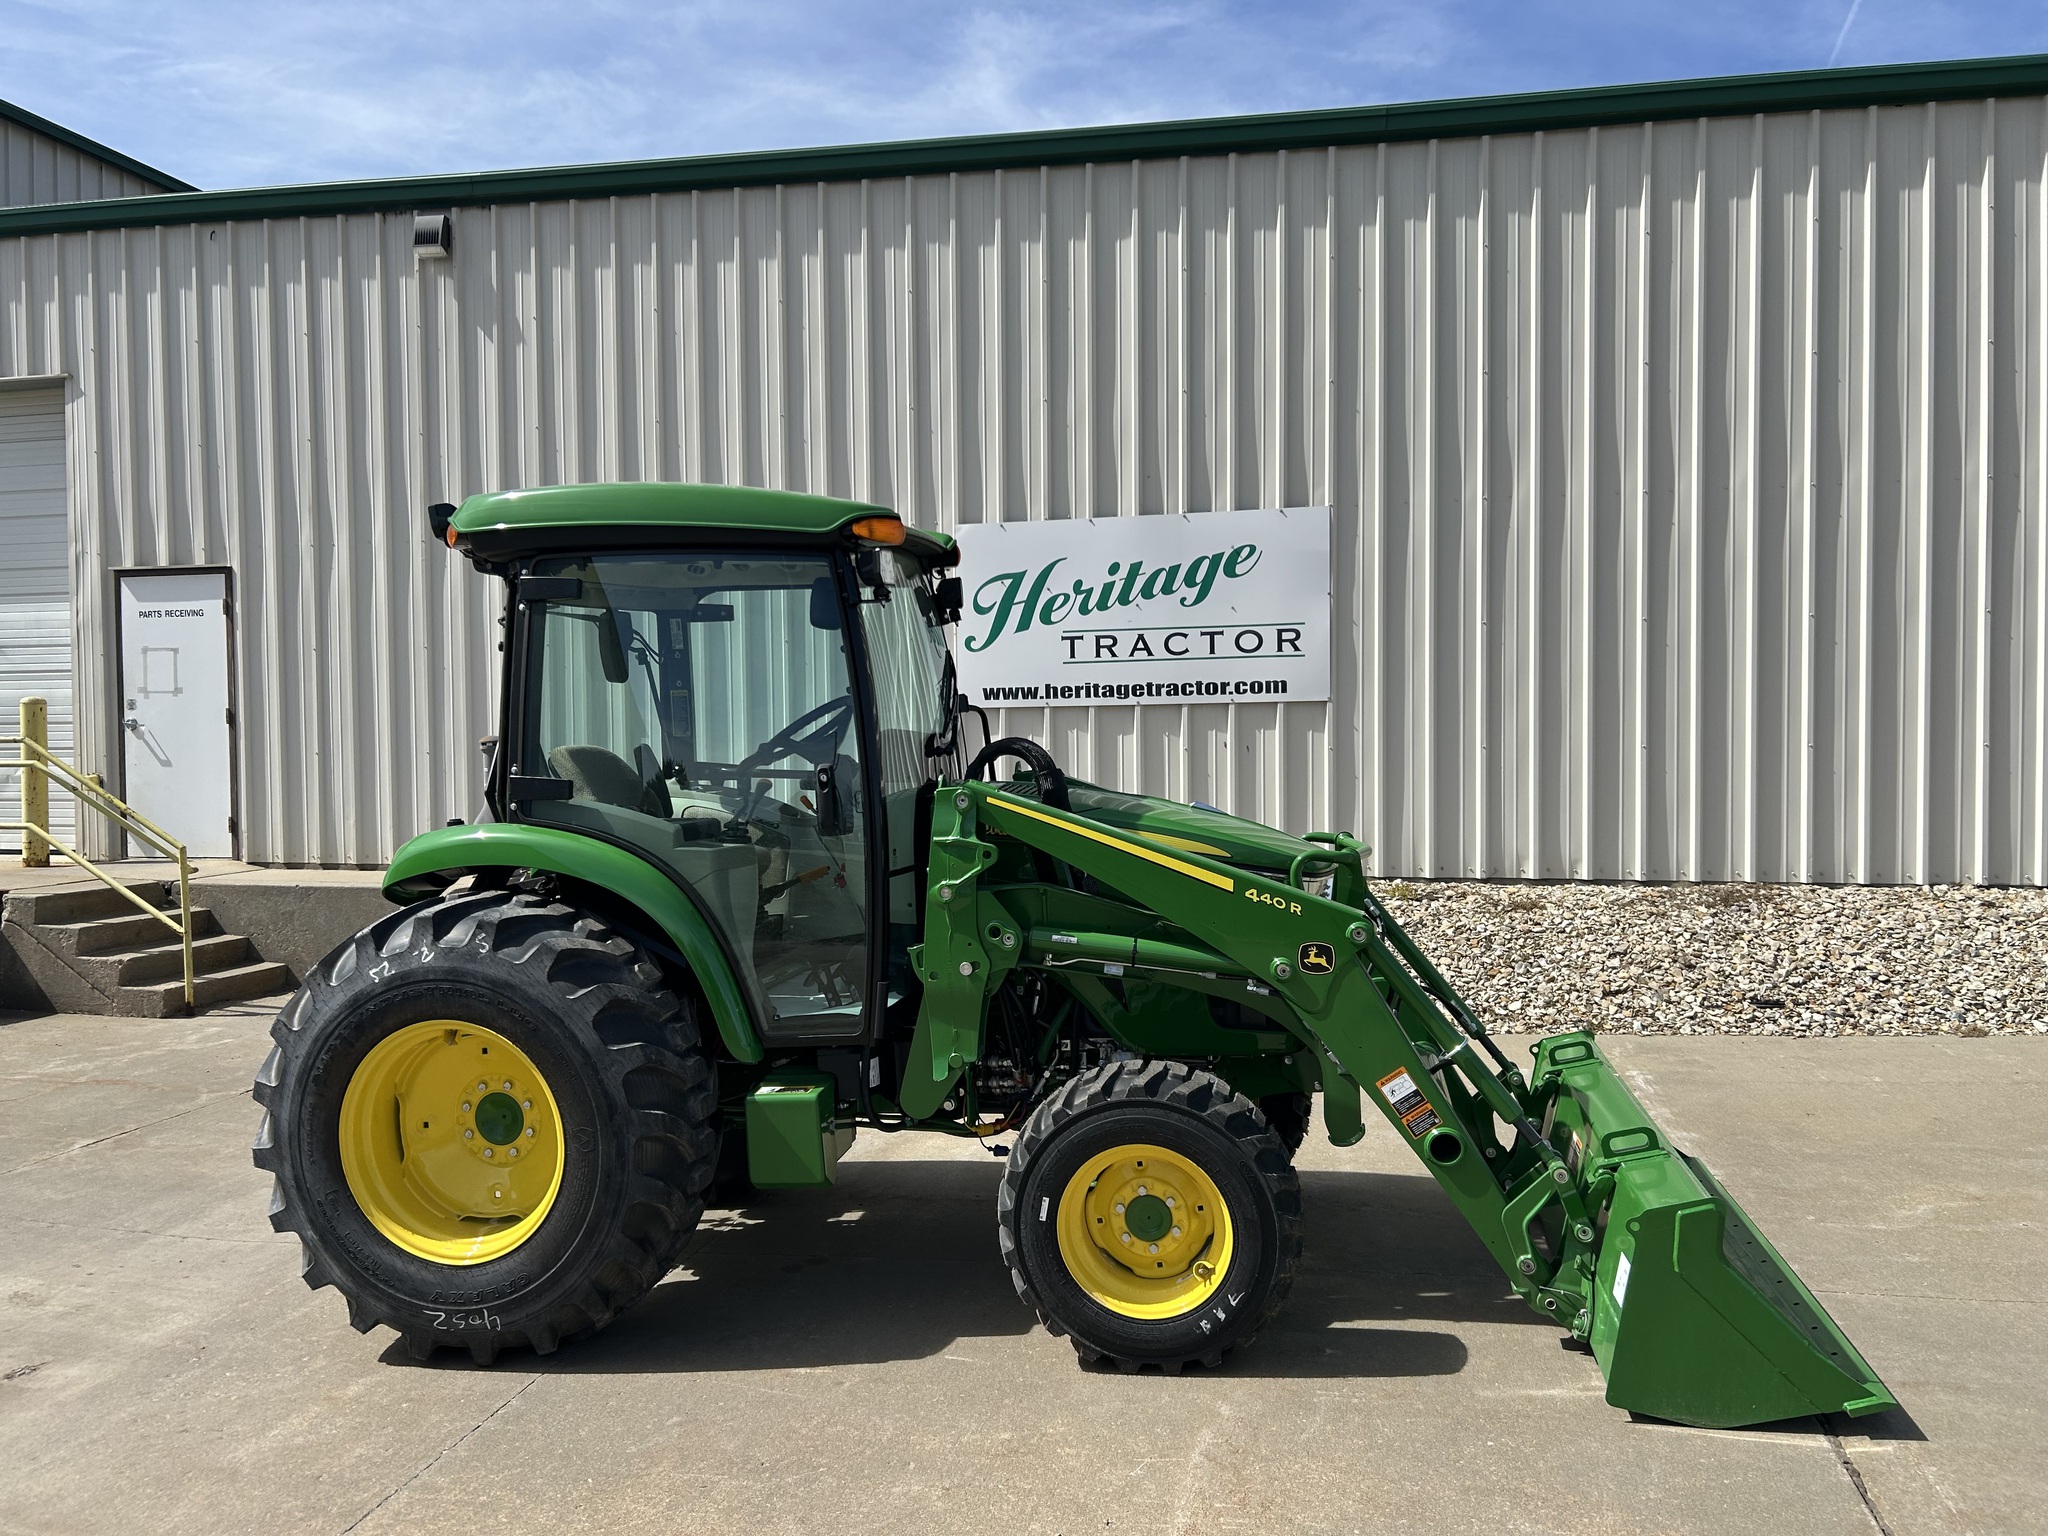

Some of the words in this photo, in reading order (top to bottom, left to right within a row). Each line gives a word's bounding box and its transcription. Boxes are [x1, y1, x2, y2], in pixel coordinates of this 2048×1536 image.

[138, 609, 162, 619] PARTS
[164, 608, 204, 618] RECEIVING
[965, 543, 1262, 653] Heritage
[1061, 628, 1302, 659] TRACTOR
[982, 679, 1288, 701] www.heritagetractor.com
[1244, 887, 1286, 910] 440
[1290, 901, 1303, 917] R
[359, 984, 490, 1019] INDUSTRIAL
[429, 1271, 531, 1304] GALAXY
